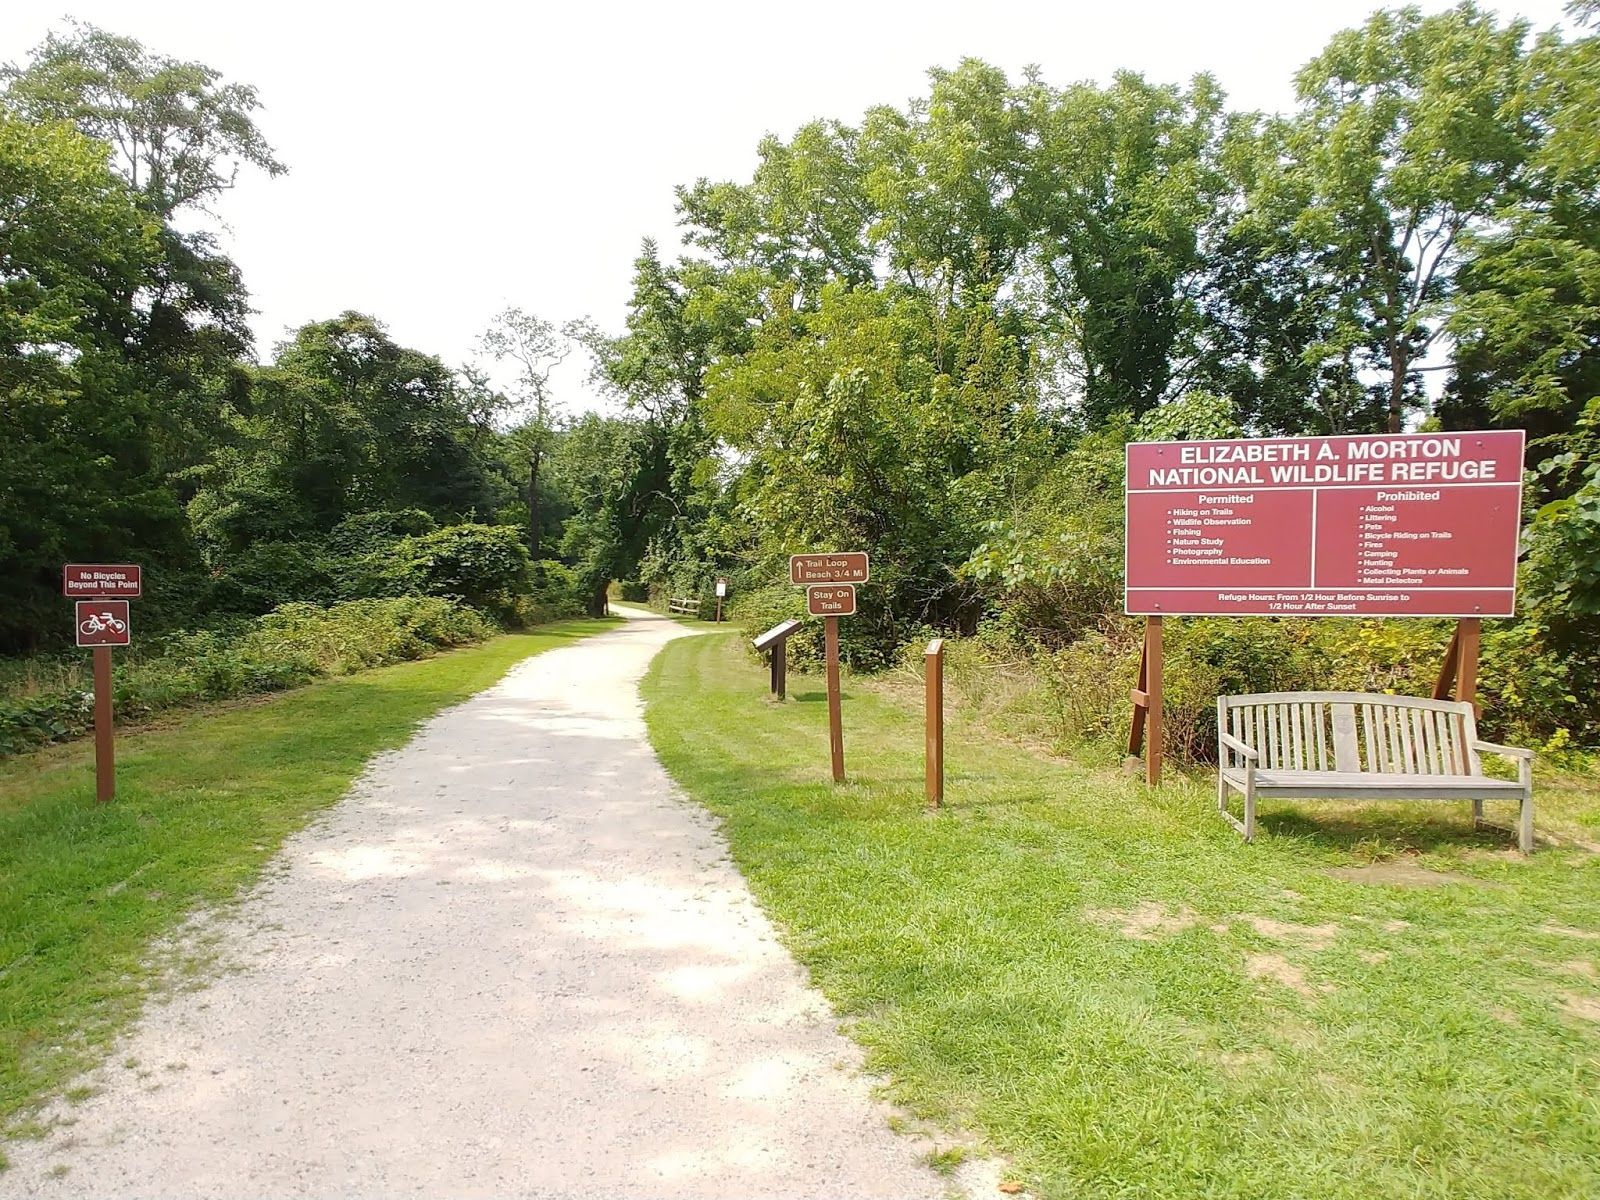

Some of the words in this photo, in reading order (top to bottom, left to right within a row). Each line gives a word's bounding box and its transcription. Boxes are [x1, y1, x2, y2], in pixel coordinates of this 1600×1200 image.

[1181, 443, 1309, 464] ELIZABETH
[1317, 442, 1340, 460] A.
[1348, 439, 1460, 459] MORTON
[1149, 467, 1264, 485] NATIONAL
[1271, 465, 1384, 482] WILDLIFE
[1392, 460, 1496, 480] REFUGE
[1198, 495, 1253, 504] Permitted
[1377, 491, 1440, 501] Prohibited
[1173, 509, 1198, 517] Hiking
[1365, 514, 1397, 522] Littering
[1173, 548, 1223, 556] Photography
[1364, 550, 1398, 558] Camping
[1364, 559, 1393, 567] Hunting
[94, 572, 126, 580] Bicycles
[1364, 568, 1401, 576] Collecting
[69, 581, 97, 589] Beyond
[1218, 594, 1247, 602] Refuge
